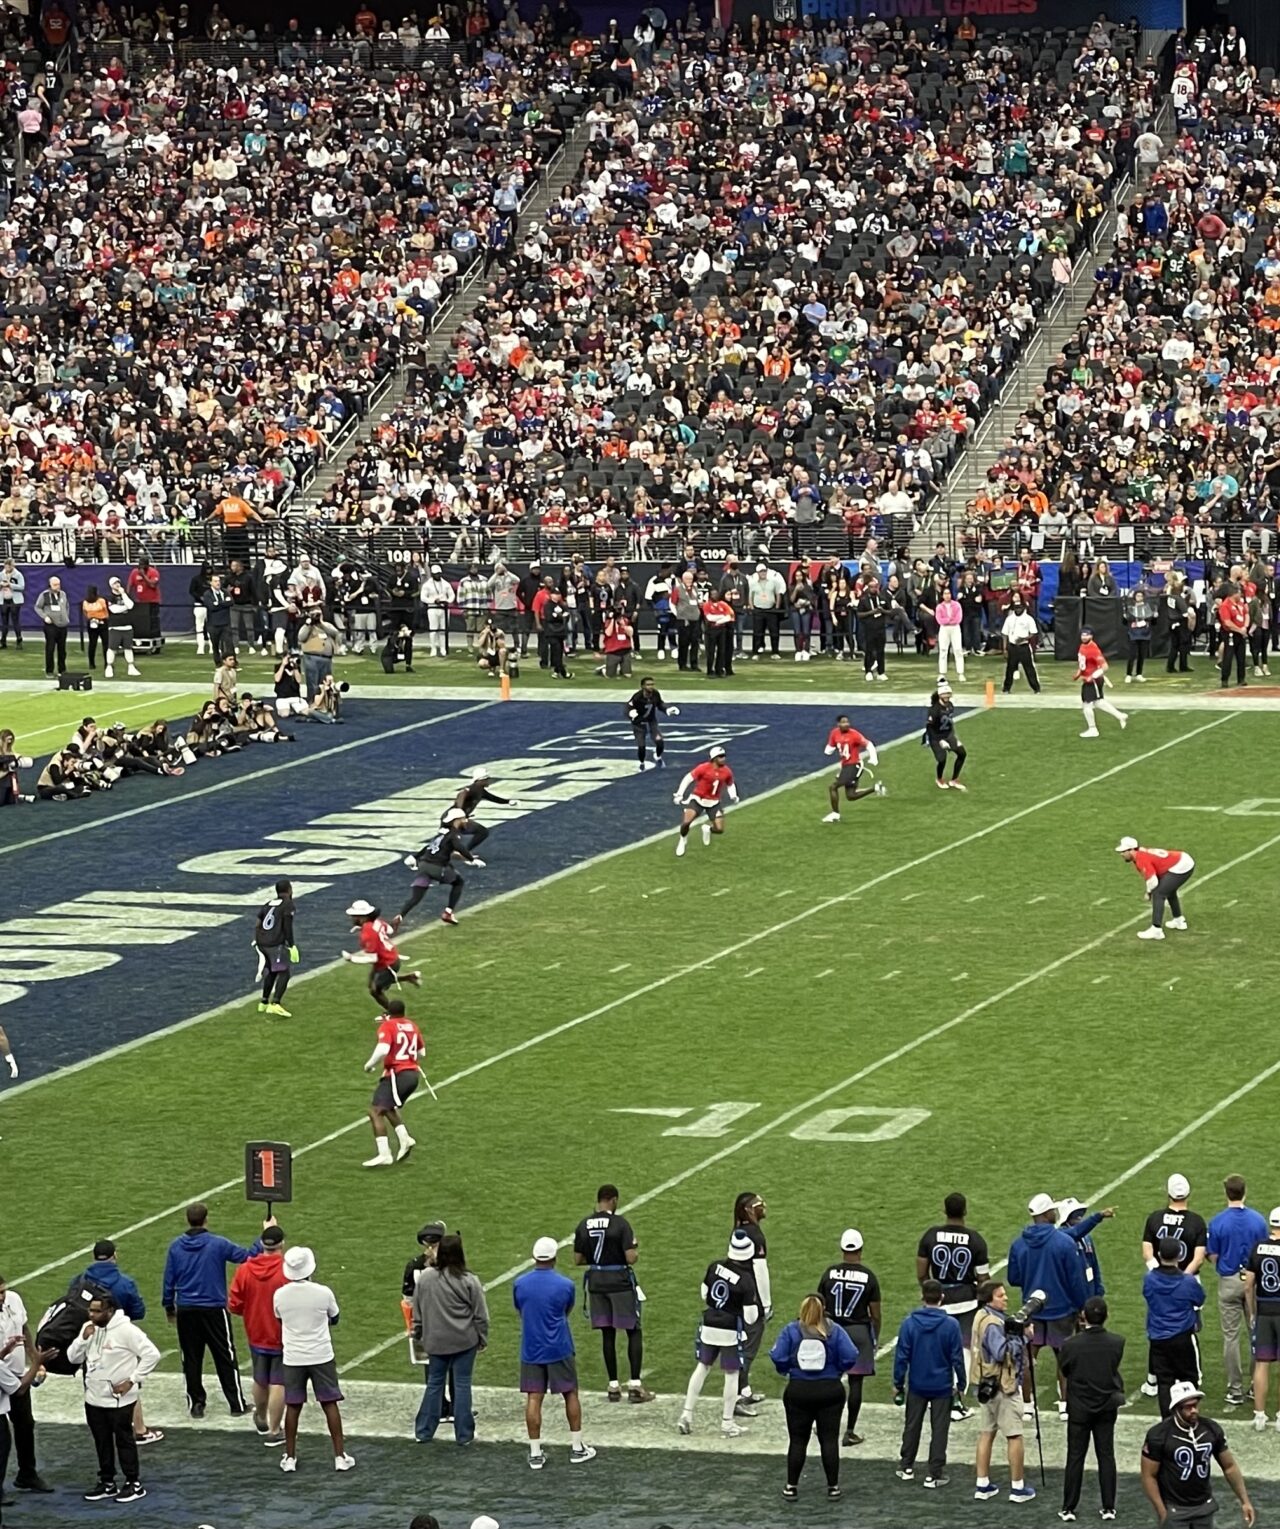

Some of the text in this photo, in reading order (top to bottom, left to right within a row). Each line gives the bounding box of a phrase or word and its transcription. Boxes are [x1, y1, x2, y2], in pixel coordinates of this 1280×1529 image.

[801, 0, 1038, 20] PRO BOWL GAMES
[46, 77, 56, 88] 17
[1177, 84, 1187, 95] 18
[17, 88, 27, 99] 19
[1170, 260, 1184, 272] 92
[352, 505, 359, 515] 7
[25, 550, 50, 563] 107
[387, 550, 412, 563] 108
[700, 548, 727, 560] C109
[711, 779, 720, 796] 1
[262, 906, 275, 930] 6
[395, 1032, 418, 1061] 24
[258, 1150, 275, 1187] 1
[586, 1218, 610, 1230] SMITH
[936, 1231, 970, 1245] HUNTER
[588, 1230, 605, 1264] 7
[932, 1244, 972, 1281] 99
[1261, 1257, 1280, 1293] 8
[711, 1279, 730, 1309] 9
[830, 1281, 865, 1317] 17
[1174, 1442, 1212, 1481] 93
